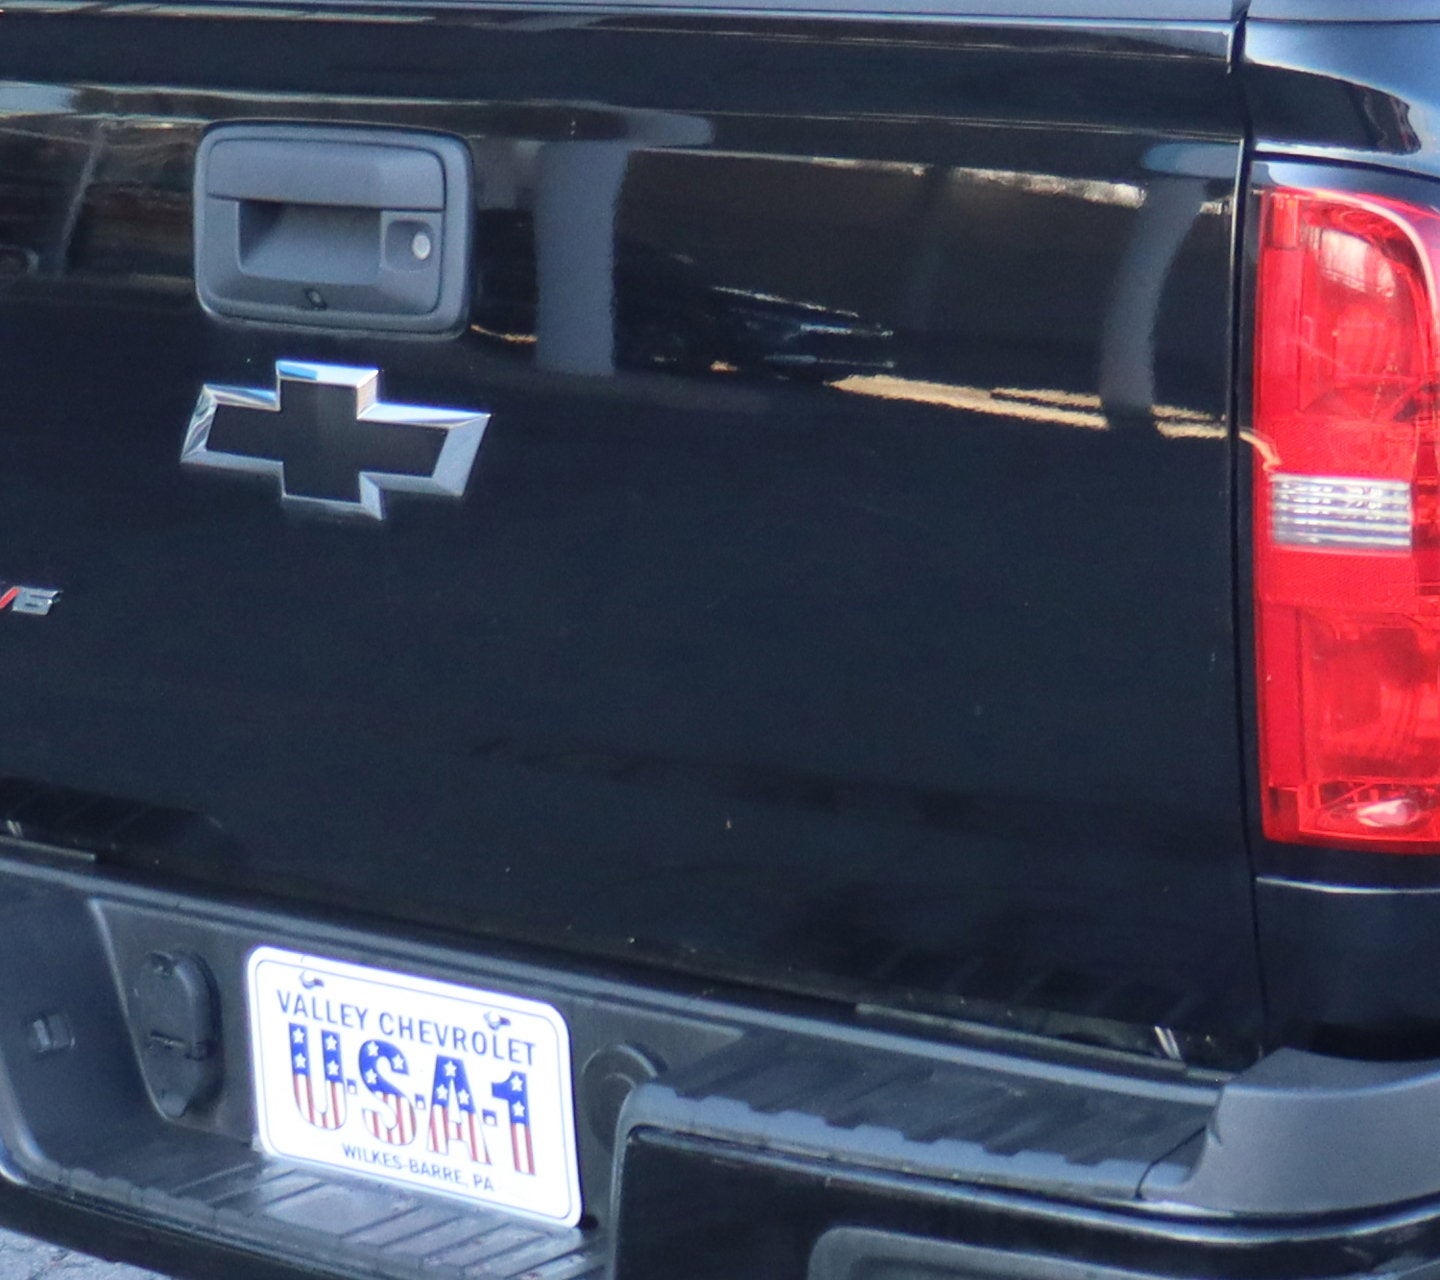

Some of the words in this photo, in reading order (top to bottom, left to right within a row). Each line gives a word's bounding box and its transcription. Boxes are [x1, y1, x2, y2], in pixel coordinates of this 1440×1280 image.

[276, 989, 369, 1031] VALLEY
[378, 1011, 537, 1067] CHEVROLET
[473, 1175, 495, 1192] PA
